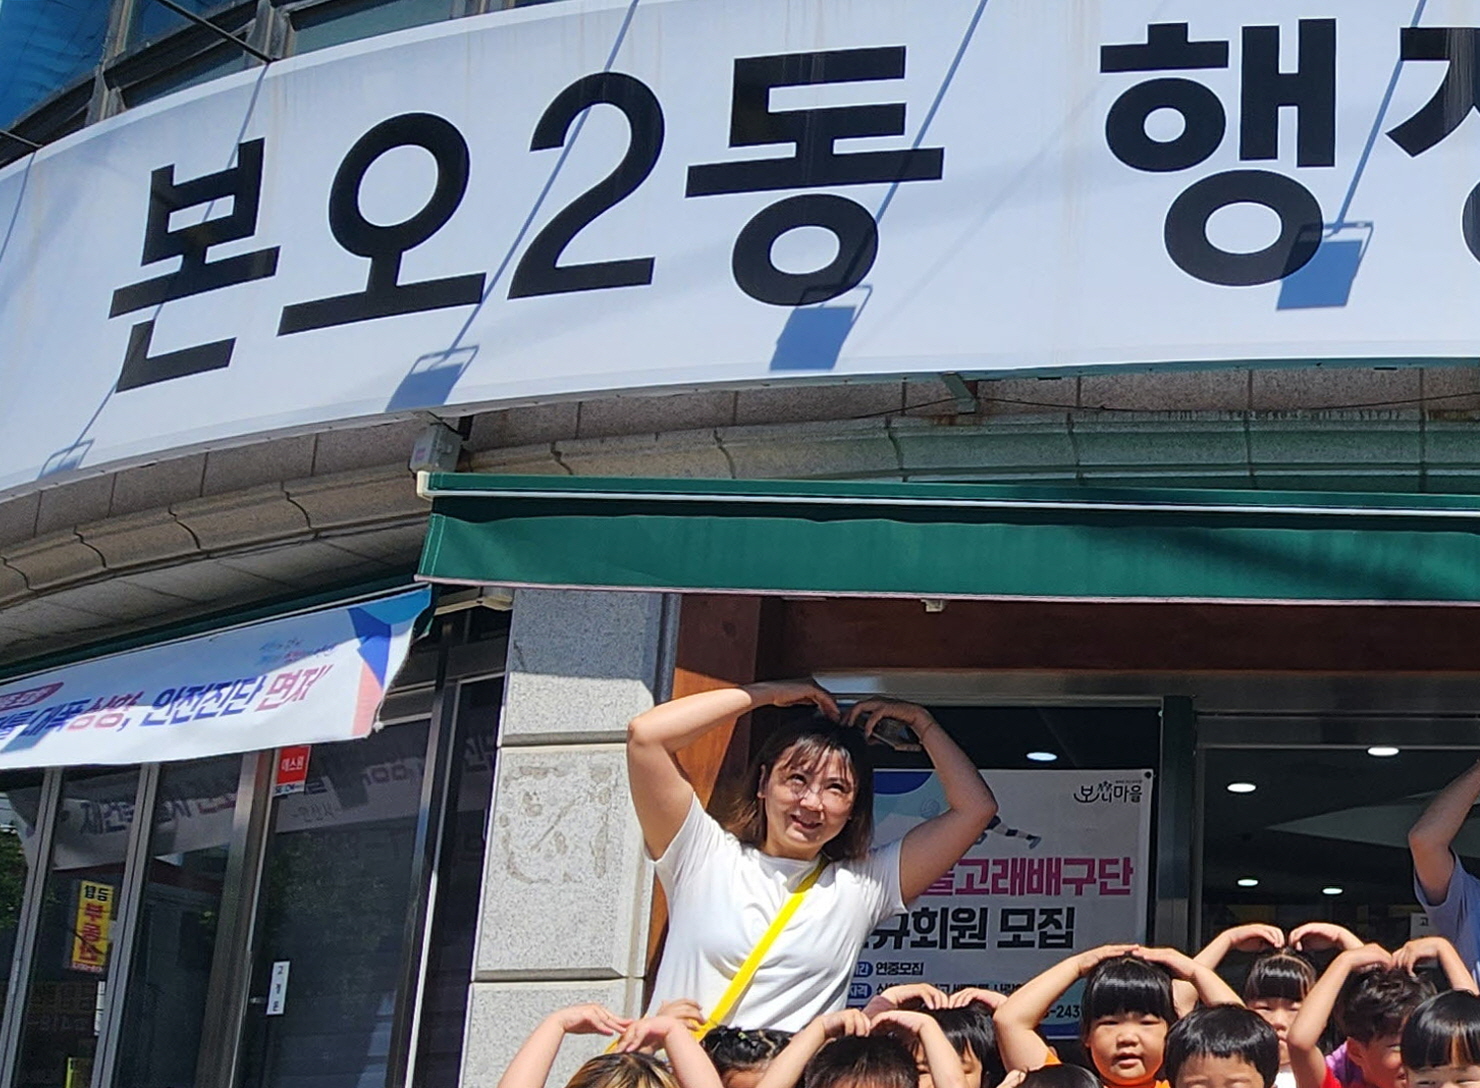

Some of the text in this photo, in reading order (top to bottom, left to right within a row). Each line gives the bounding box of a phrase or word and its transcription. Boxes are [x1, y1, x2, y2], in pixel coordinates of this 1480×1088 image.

[109, 45, 945, 393] 본오2동
[997, 907, 1076, 950] 모집
[875, 961, 924, 976] 연중모집
